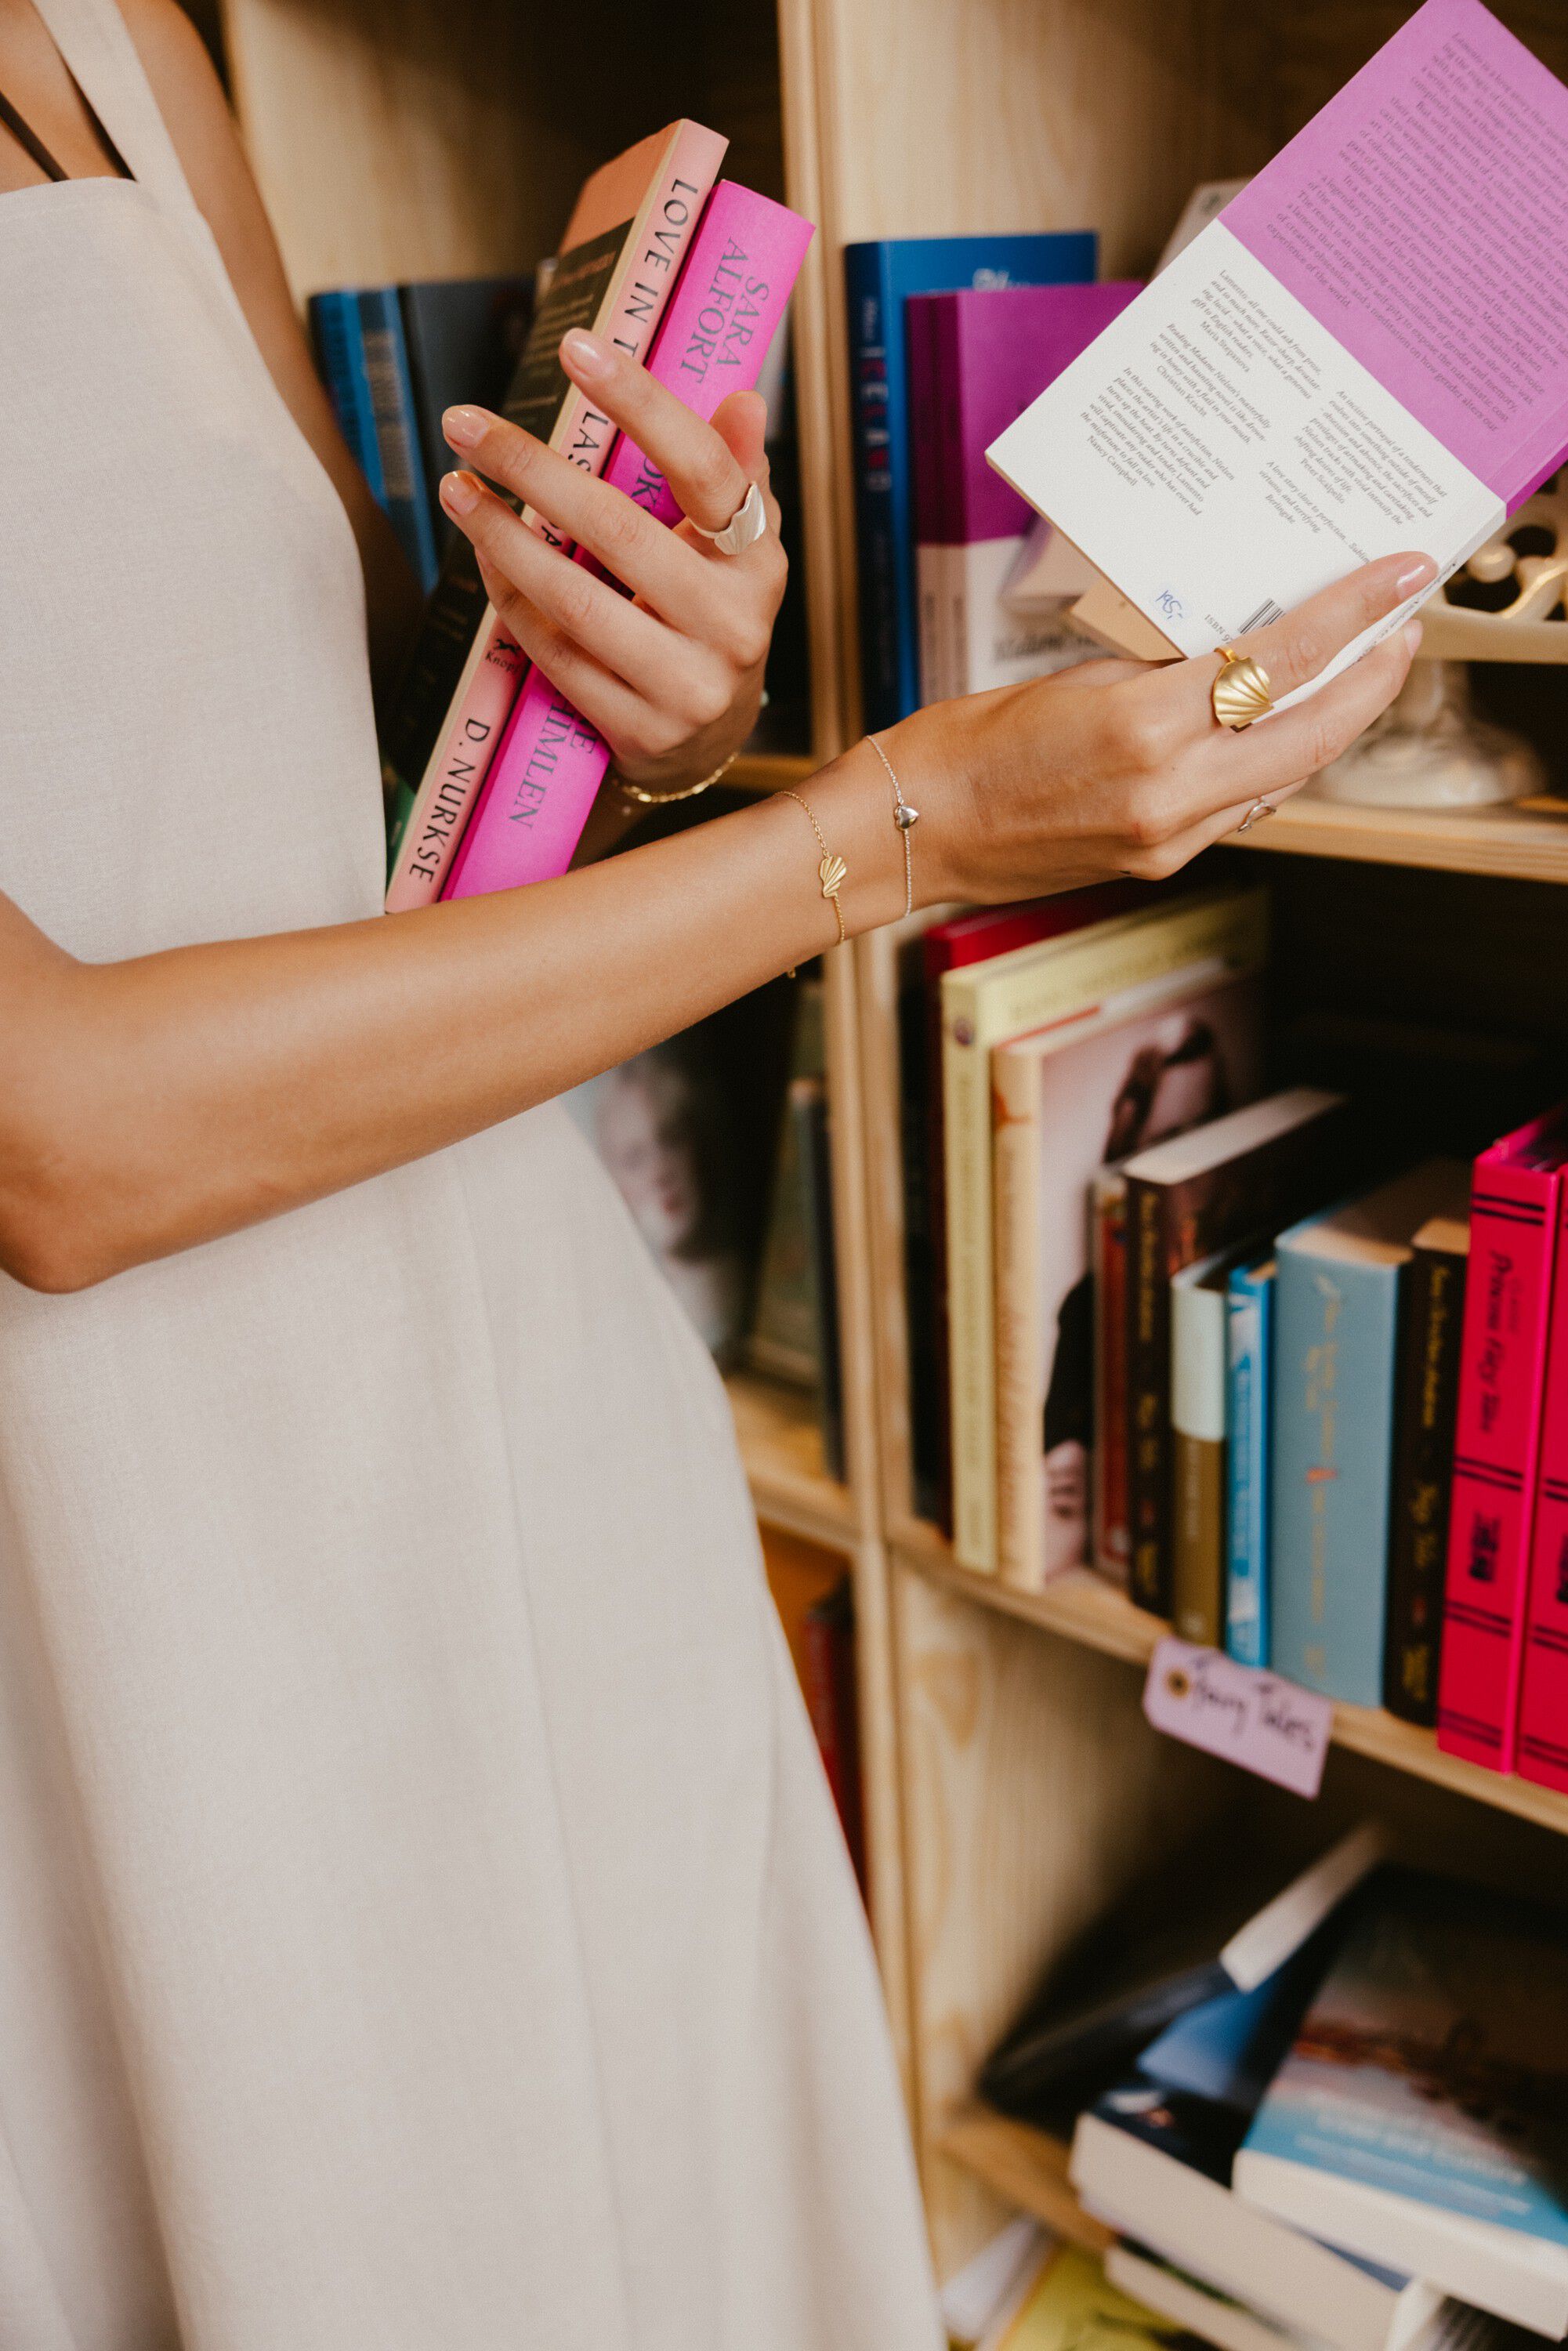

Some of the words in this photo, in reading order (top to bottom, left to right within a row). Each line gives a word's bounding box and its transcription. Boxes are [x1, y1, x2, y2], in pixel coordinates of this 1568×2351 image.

[645, 179, 697, 271] LOVE
[625, 282, 658, 323] IN
[680, 237, 748, 383] ALFORT
[717, 277, 769, 366] SARA
[1190, 296, 1207, 310] gift
[1209, 312, 1235, 338] English
[1200, 320, 1220, 342] Maria
[1210, 279, 1226, 293] and
[1228, 297, 1248, 316] much
[1246, 299, 1259, 310] all
[1255, 306, 1268, 321] one
[1265, 317, 1285, 335] could
[1280, 332, 1295, 346] ask
[1288, 341, 1307, 359] from
[1150, 339, 1162, 355] ing
[1165, 355, 1185, 379] honey
[1182, 374, 1199, 389] with
[1197, 389, 1216, 407] flail
[1215, 410, 1233, 426] your
[1156, 364, 1186, 396] Christian
[1158, 332, 1181, 355] written
[1177, 352, 1193, 367] and
[1189, 361, 1217, 393] haunting
[1214, 389, 1233, 407] novel
[1234, 408, 1248, 423] like
[1167, 321, 1192, 350] Reading
[1189, 344, 1216, 373] Madame
[1238, 395, 1272, 431] masterfully
[1211, 297, 1231, 316] lucid
[1231, 318, 1250, 336] what
[1251, 338, 1268, 357] voice,
[1266, 353, 1284, 371] what
[1284, 372, 1312, 400] generous
[1080, 411, 1092, 424] the
[1088, 421, 1121, 453] misfortune
[1123, 455, 1139, 469] fall
[1086, 435, 1107, 460] Nancy
[1105, 454, 1138, 487] Campbell
[1088, 403, 1104, 416] will
[1099, 413, 1127, 442] captivate
[1124, 439, 1138, 455] any
[1135, 450, 1156, 470] reader
[1153, 468, 1168, 483] who
[1164, 478, 1178, 493] has
[1175, 490, 1190, 505] ever
[1186, 500, 1203, 516] had
[1097, 394, 1114, 412] vivid,
[1111, 408, 1148, 447] smouldering
[1145, 442, 1161, 457] and
[1157, 453, 1177, 476] tender,
[1175, 471, 1204, 502] Lamento
[1106, 384, 1124, 403] turns
[1128, 407, 1141, 420] the
[1138, 416, 1154, 434] heat.
[1160, 439, 1178, 458] turns
[1175, 454, 1199, 478] defiant
[1195, 475, 1210, 489] and
[1112, 376, 1135, 397] places
[1132, 393, 1144, 406] the
[1161, 421, 1173, 436] life
[1181, 444, 1206, 469] crucible
[1203, 466, 1219, 480] and
[1129, 373, 1143, 388] this
[1140, 385, 1164, 411] searing
[1161, 406, 1179, 422] work
[1211, 455, 1235, 480] Nielsen
[1293, 434, 1317, 460] shifting
[1314, 453, 1336, 477] desires
[1299, 457, 1318, 477] Peter
[1308, 417, 1339, 445] privileges
[1342, 448, 1374, 482] artmaking
[1371, 476, 1388, 491] and
[1322, 410, 1350, 438] obsession
[1347, 435, 1363, 450] and
[1359, 446, 1383, 473] absence,
[1382, 469, 1394, 482] the
[1392, 479, 1421, 507] sacrifices
[1417, 504, 1433, 519] and
[1328, 399, 1350, 421] evolves
[1347, 417, 1362, 433] into
[1359, 429, 1390, 462] something
[1387, 457, 1410, 480] outside
[1413, 483, 1438, 507] oneself
[1345, 397, 1369, 422] incisive
[1363, 418, 1396, 447] portrayal
[1402, 454, 1434, 487] tenderness
[1431, 482, 1447, 498] that
[1258, 469, 1282, 496] virtuoso,
[1281, 492, 1297, 507] and
[1271, 463, 1285, 480] love
[1282, 476, 1299, 495] story
[1296, 491, 1313, 508] close
[1348, 540, 1371, 565] Sublim
[1302, 423, 1325, 449] Nielsen
[1322, 445, 1342, 465] tracks
[1339, 463, 1357, 479] with
[1353, 476, 1371, 493] vivid
[1367, 488, 1393, 518] intensity
[1390, 513, 1403, 526] the
[1204, 614, 1226, 635] ISBN
[458, 718, 491, 747] D.
[409, 758, 476, 883] NURKSE
